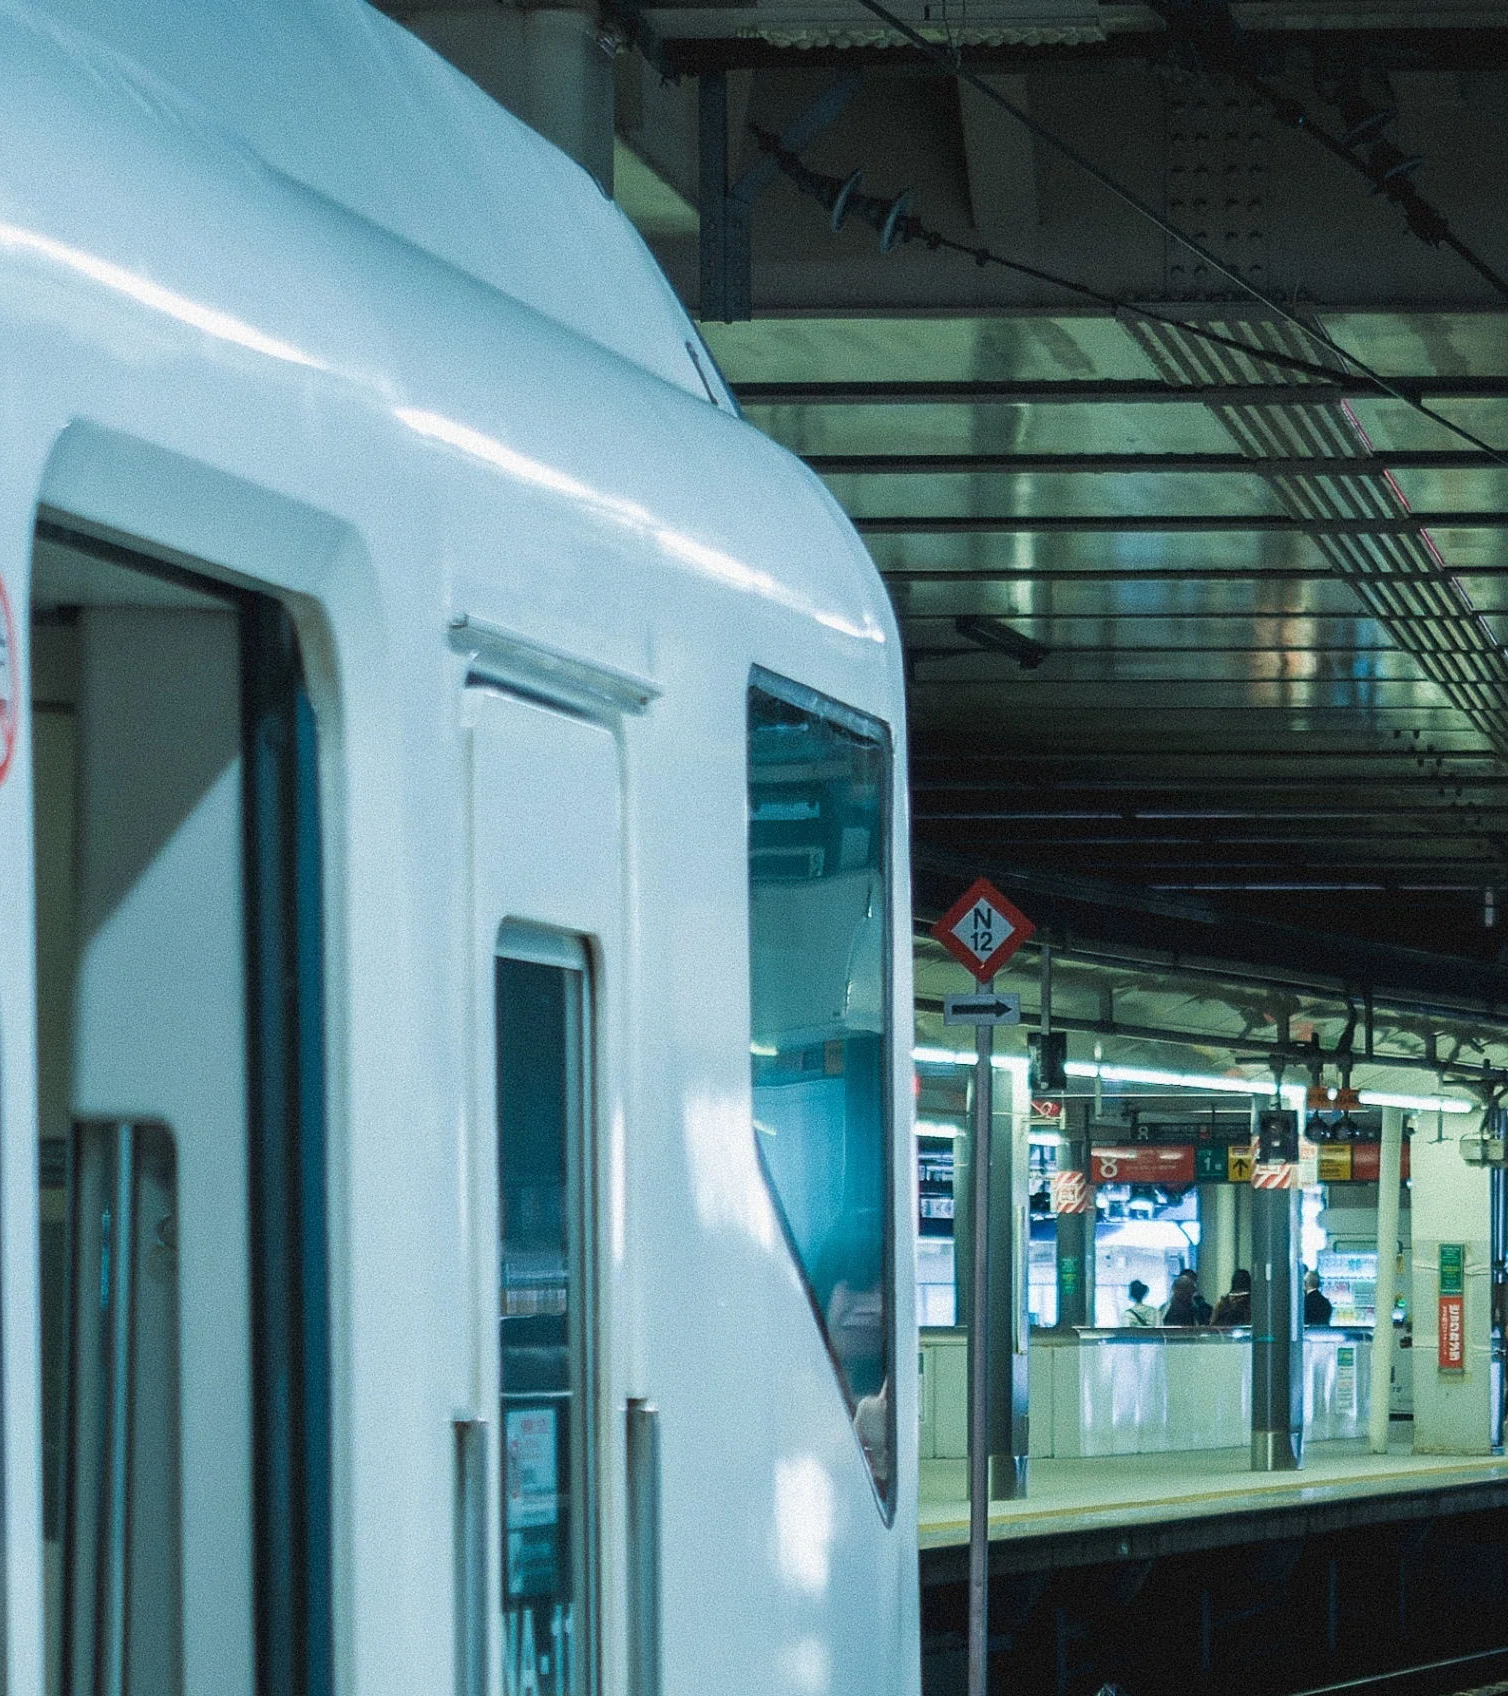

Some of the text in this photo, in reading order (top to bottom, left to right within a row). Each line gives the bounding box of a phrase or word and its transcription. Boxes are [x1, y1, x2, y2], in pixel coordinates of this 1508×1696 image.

[972, 906, 992, 929] N
[970, 931, 994, 953] 12
[1100, 1154, 1118, 1178] 8
